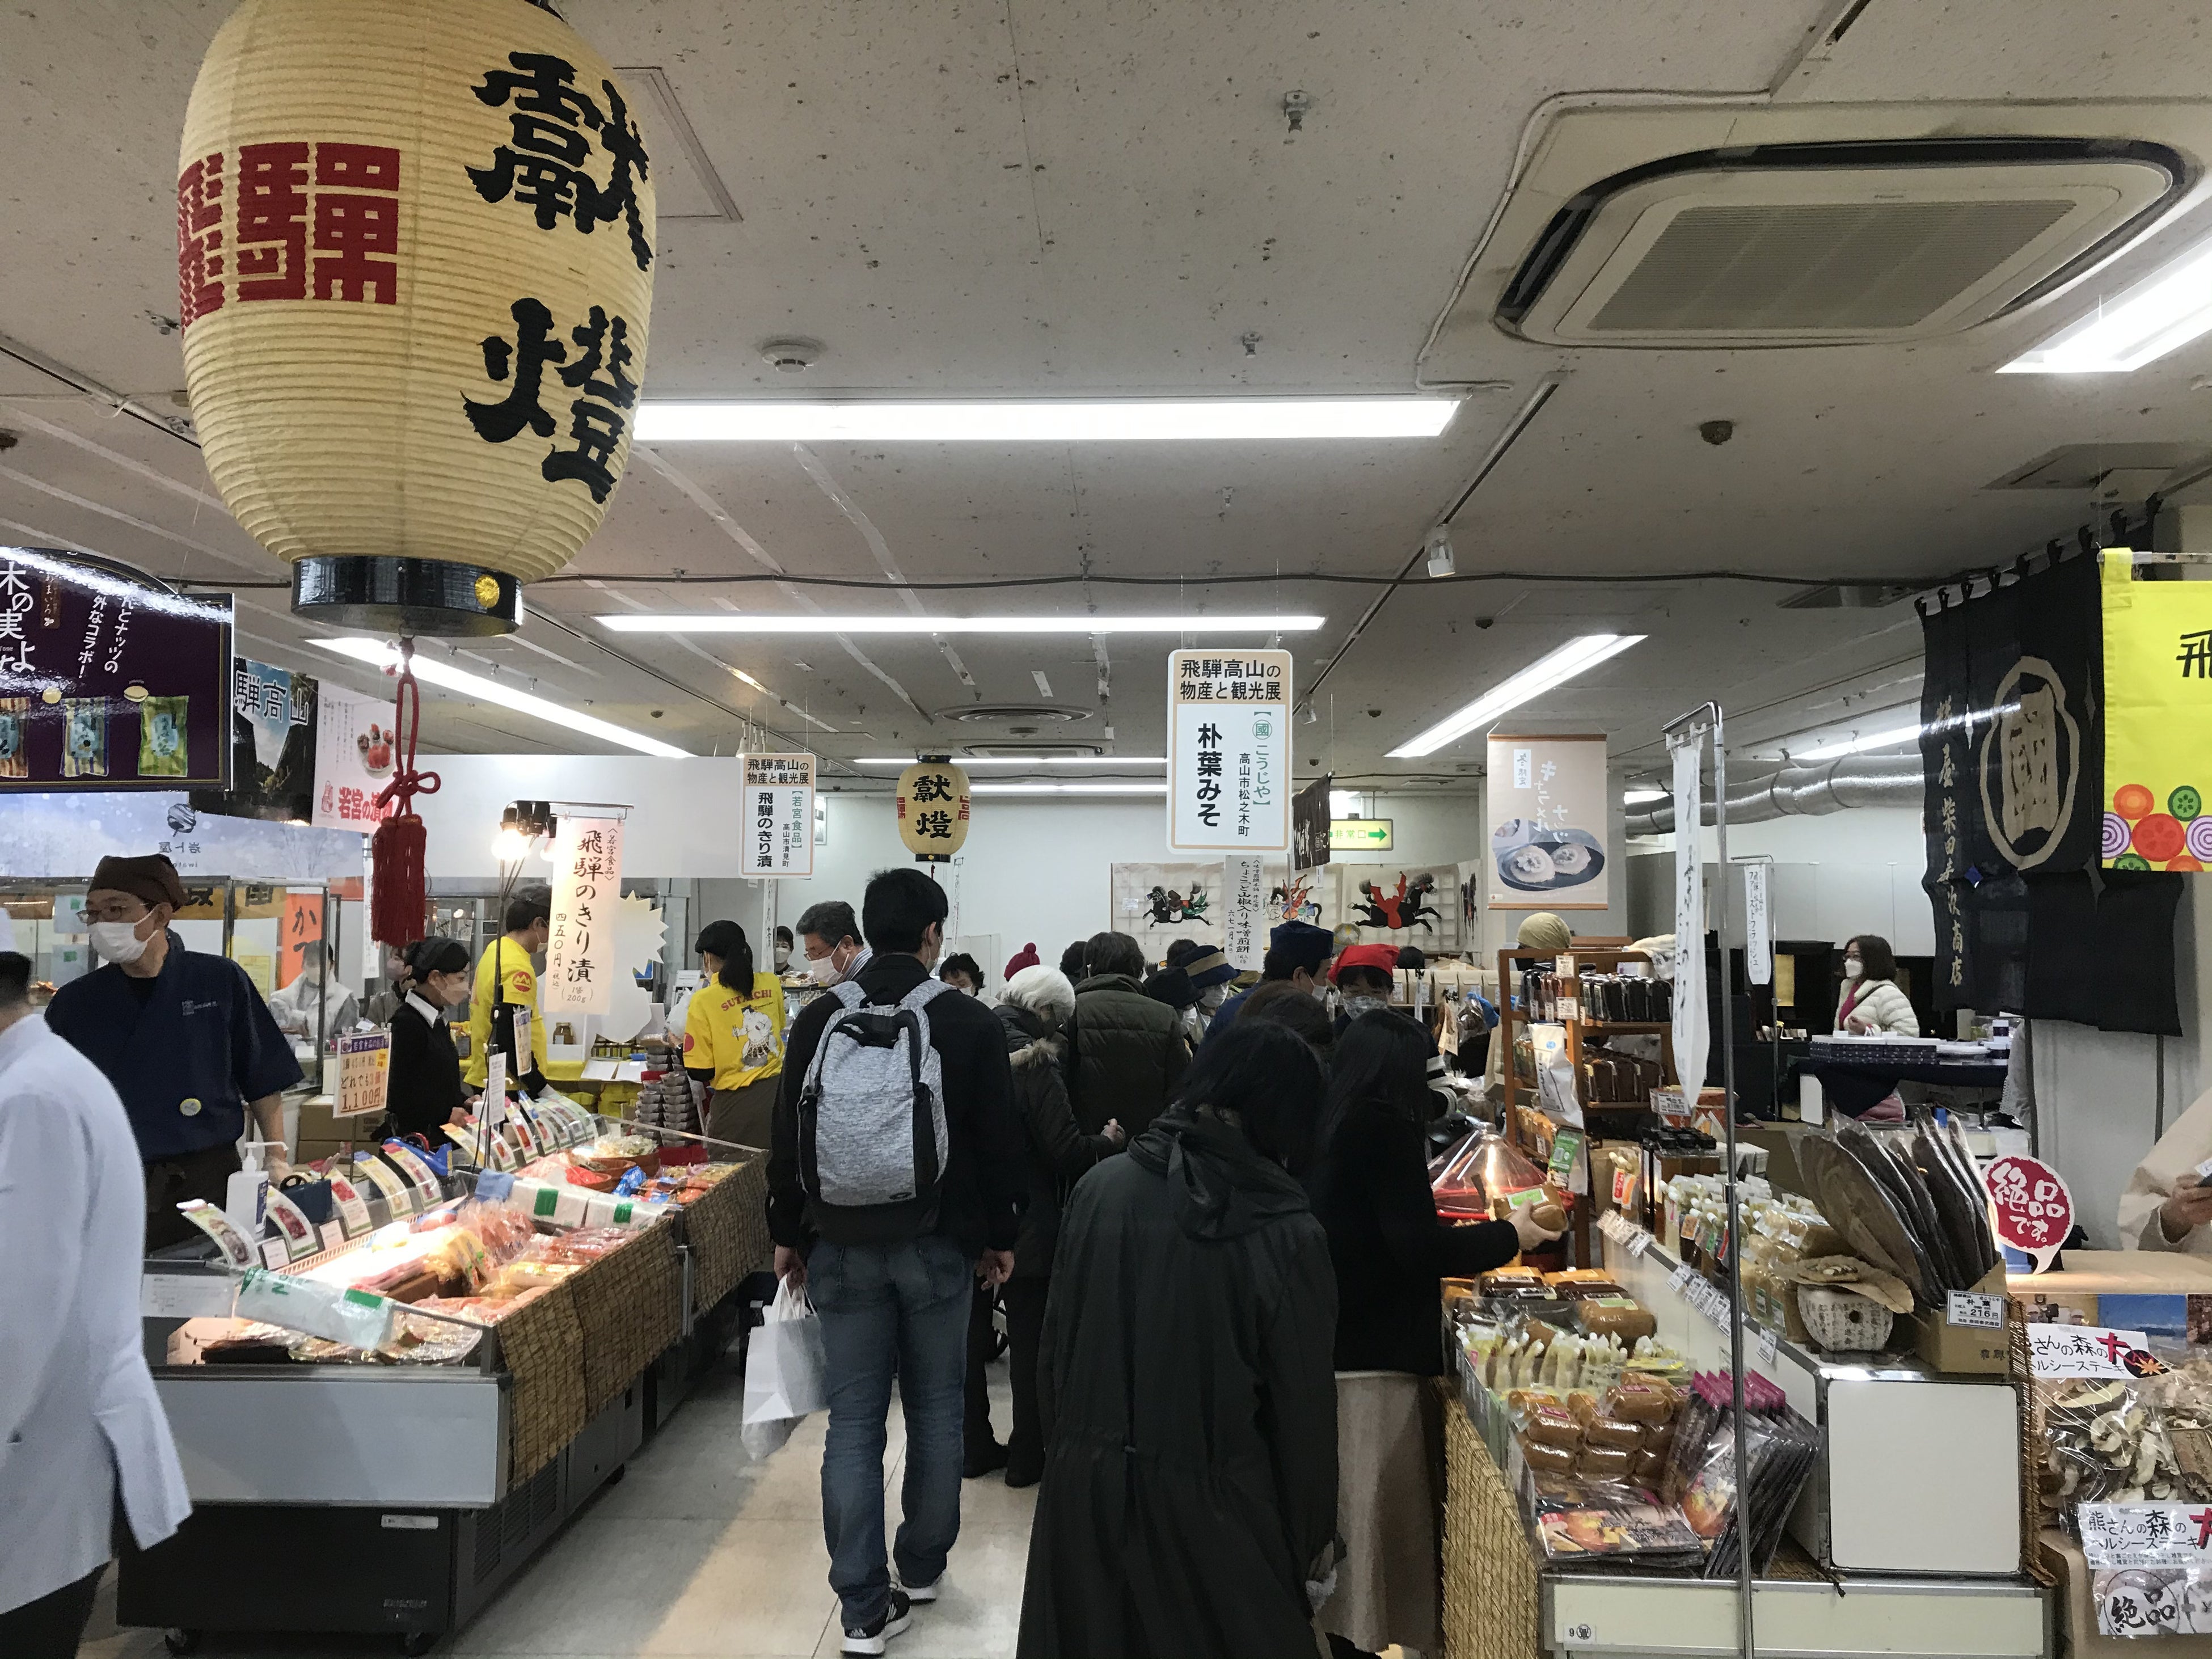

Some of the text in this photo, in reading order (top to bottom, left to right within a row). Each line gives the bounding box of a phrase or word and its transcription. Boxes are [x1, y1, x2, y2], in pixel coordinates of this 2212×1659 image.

[1180, 659, 1281, 678] 飛騨高山の
[1180, 681, 1282, 701] 物産と観光展
[747, 772, 809, 784] 物産と観光展
[748, 759, 809, 771] 飛騨高山の
[1196, 723, 1223, 828] 朴葉みそ
[1238, 752, 1251, 837] 高山市松之木町
[757, 792, 773, 867] 飛騨のきり漬
[782, 823, 790, 868] 高山市清見町
[1335, 829, 1366, 840] 非常口
[567, 829, 604, 983] 飛騨のきり漬
[1991, 1162, 2066, 1218] 絶品
[2029, 1335, 2109, 1358] さんの森の
[2111, 1588, 2176, 1633] 絶品
